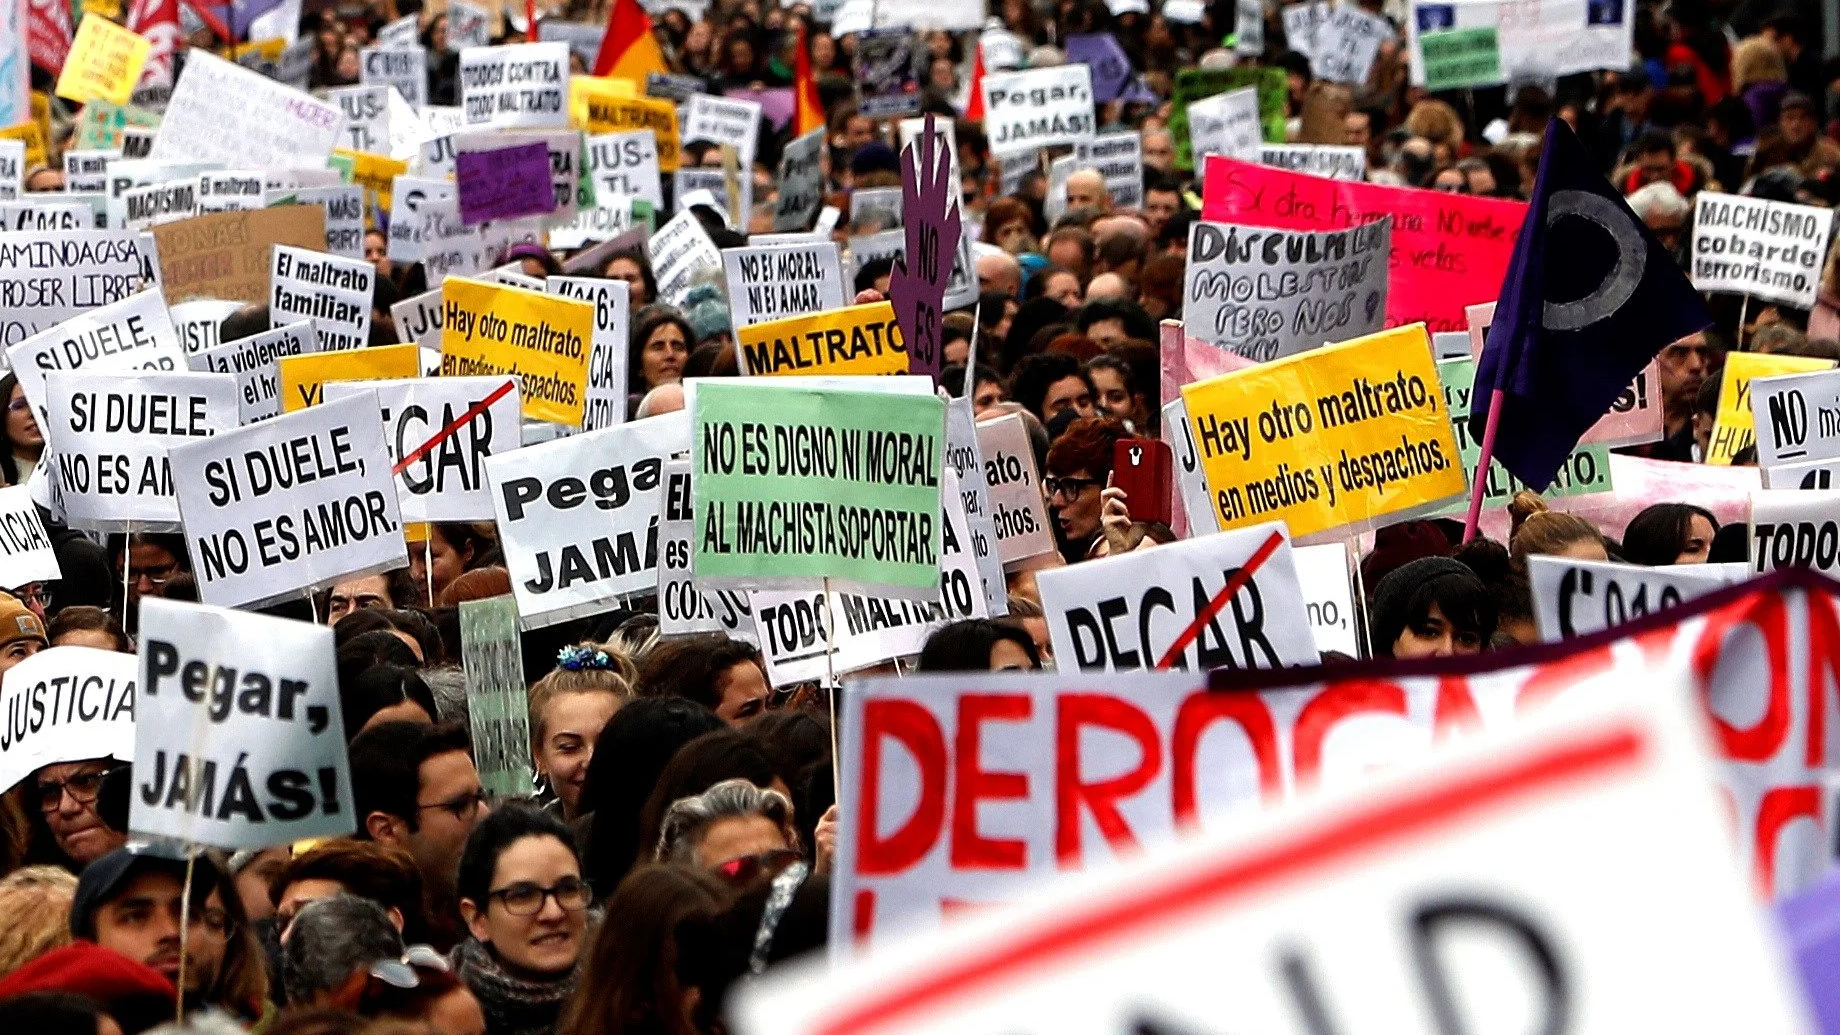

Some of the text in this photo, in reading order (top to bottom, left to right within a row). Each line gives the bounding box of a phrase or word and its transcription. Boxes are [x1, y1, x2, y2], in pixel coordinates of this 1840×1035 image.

[990, 84, 1088, 108] Pegar,
[996, 112, 1091, 142] JAMÁS!
[740, 252, 825, 285] NO ES MORAL,
[1697, 233, 1818, 267] cobarde
[26, 278, 66, 307] SER
[72, 272, 137, 307] LIBRE
[277, 250, 367, 292] El maltrato
[1696, 259, 1812, 294] terrorismo.
[749, 288, 823, 315] NI ES AMAR,
[1215, 303, 1284, 338] PERO
[444, 298, 586, 362] Hay otro maltrato,
[69, 393, 98, 433] SI
[245, 384, 262, 406] el
[1198, 370, 1437, 460] Hay otro maltrato,
[1769, 389, 1808, 449] NO
[60, 454, 129, 495] NO ES
[204, 427, 366, 508] SI DUELE,
[703, 423, 939, 486] NO ES DIGNO NI MORAL
[1218, 437, 1452, 518] en medios despachos.
[196, 490, 398, 583] NO ES AMOR.
[703, 503, 937, 565] AL MACHISTA SOPORTAR.
[145, 638, 329, 736] Pegar,
[139, 749, 343, 824] JAMÁS!
